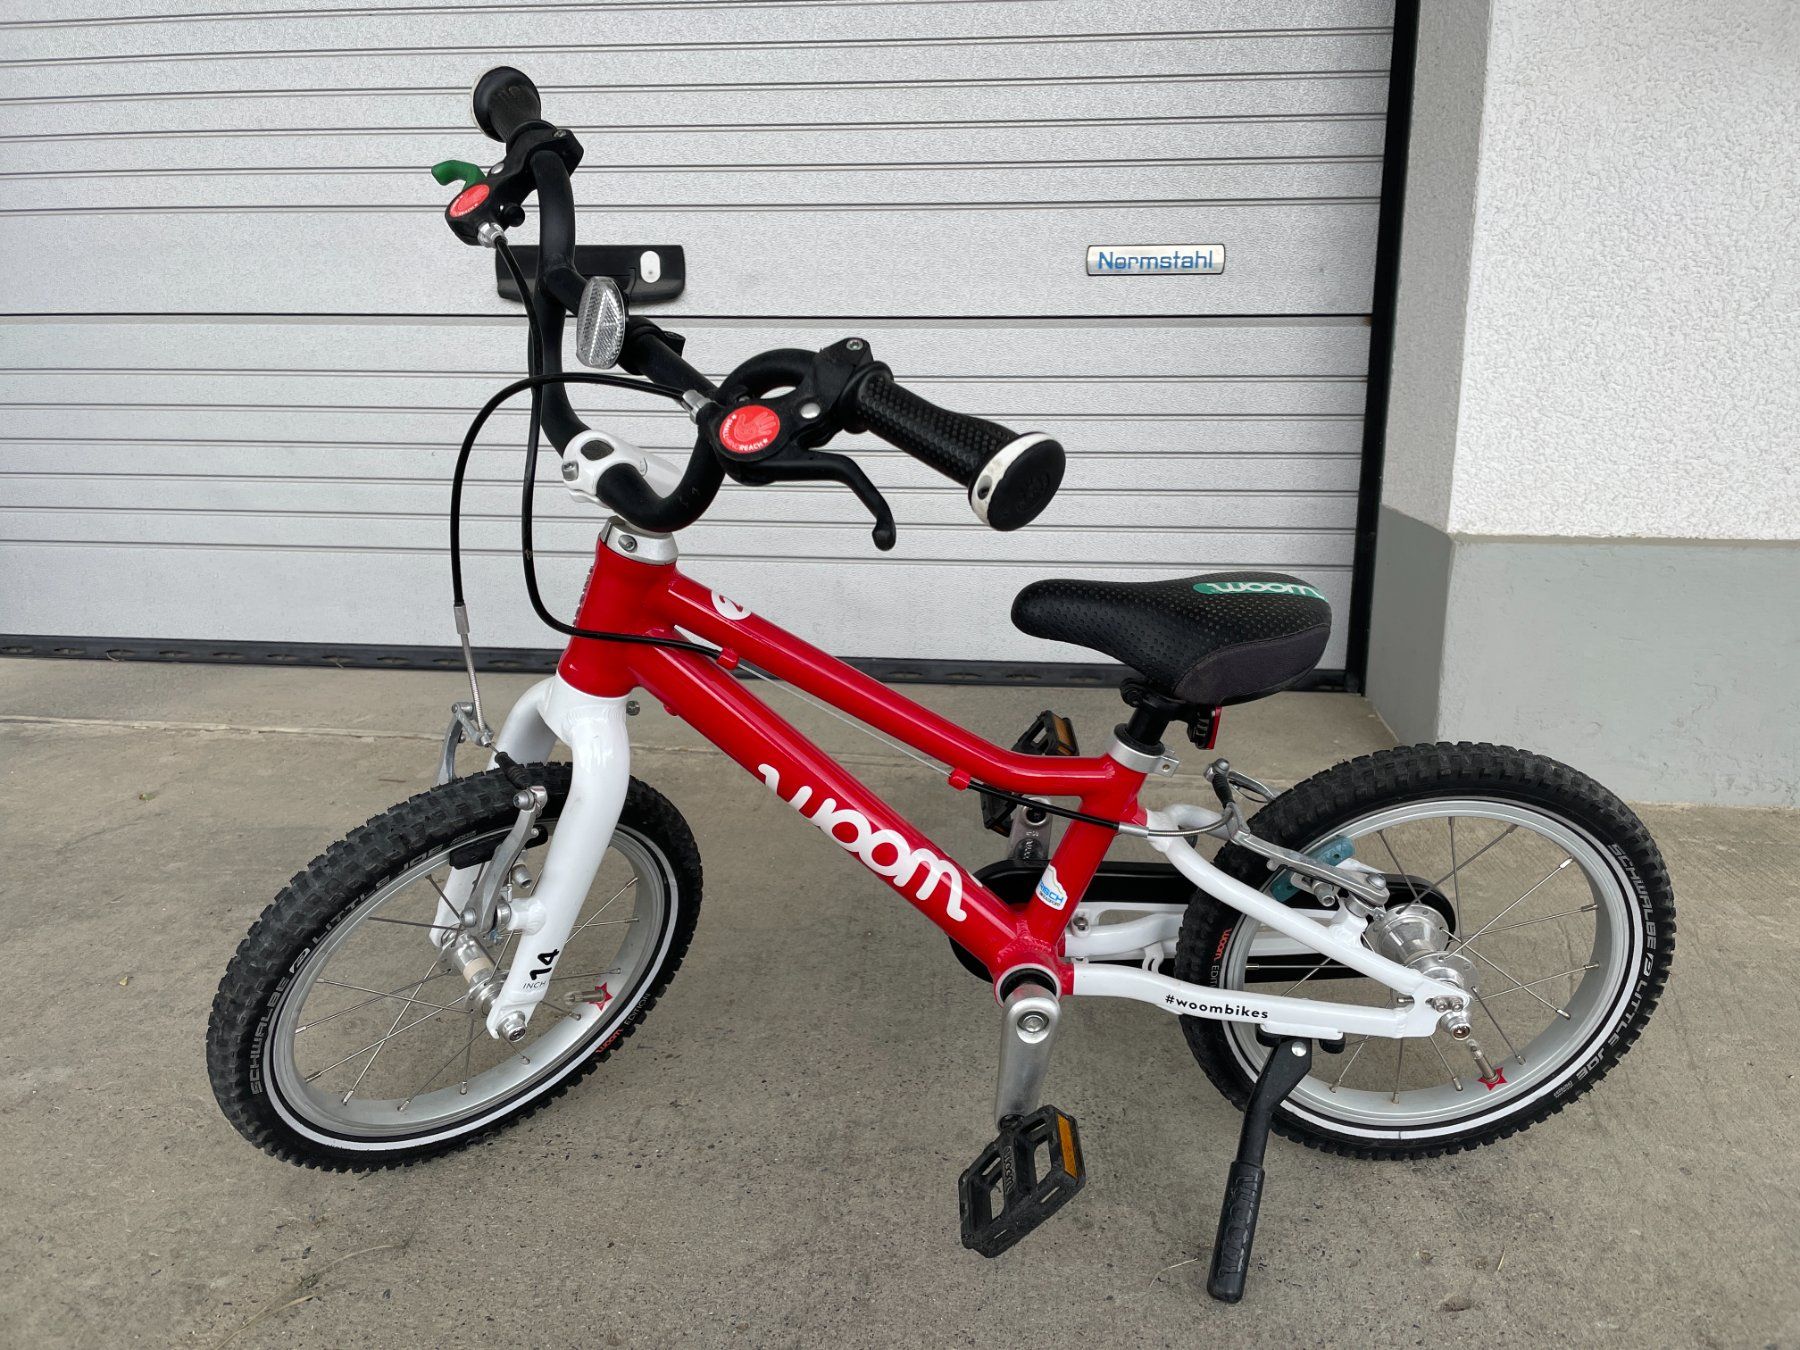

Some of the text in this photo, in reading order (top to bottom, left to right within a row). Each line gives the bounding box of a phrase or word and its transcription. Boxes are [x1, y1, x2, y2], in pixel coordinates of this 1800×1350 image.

[1097, 250, 1213, 270] Normstahl
[738, 441, 764, 452] REACH
[1207, 582, 1328, 603] woom
[758, 763, 968, 922] woom
[529, 948, 560, 981] 14
[1576, 843, 1657, 1080] SCHWALBE LITTLE JOE
[249, 976, 290, 1095] SCHWALBE
[312, 875, 390, 945] LITTLE
[522, 980, 547, 990] INCH
[1164, 994, 1269, 1019] #woombikes
